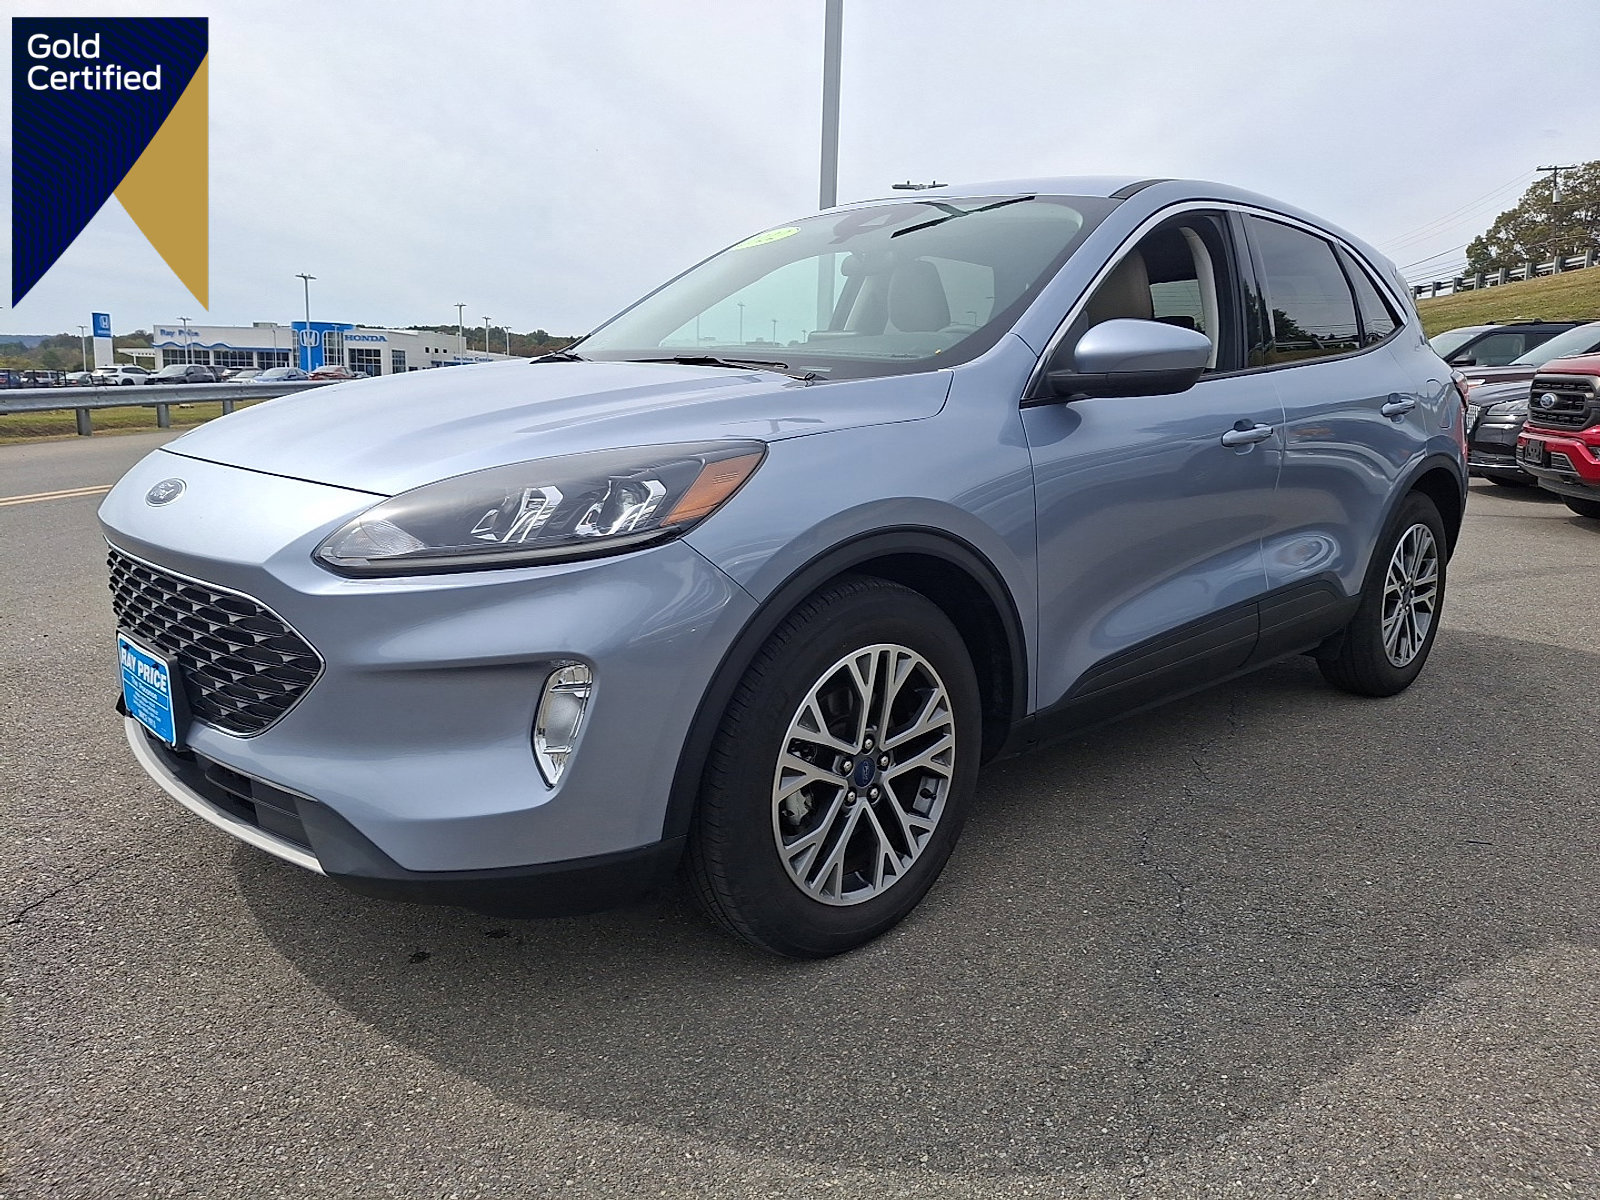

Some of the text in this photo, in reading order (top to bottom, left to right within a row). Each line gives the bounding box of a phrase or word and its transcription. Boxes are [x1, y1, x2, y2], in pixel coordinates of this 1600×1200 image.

[344, 334, 387, 342] HONDA
[121, 647, 136, 672] RAY
[138, 660, 167, 692] PRICE
